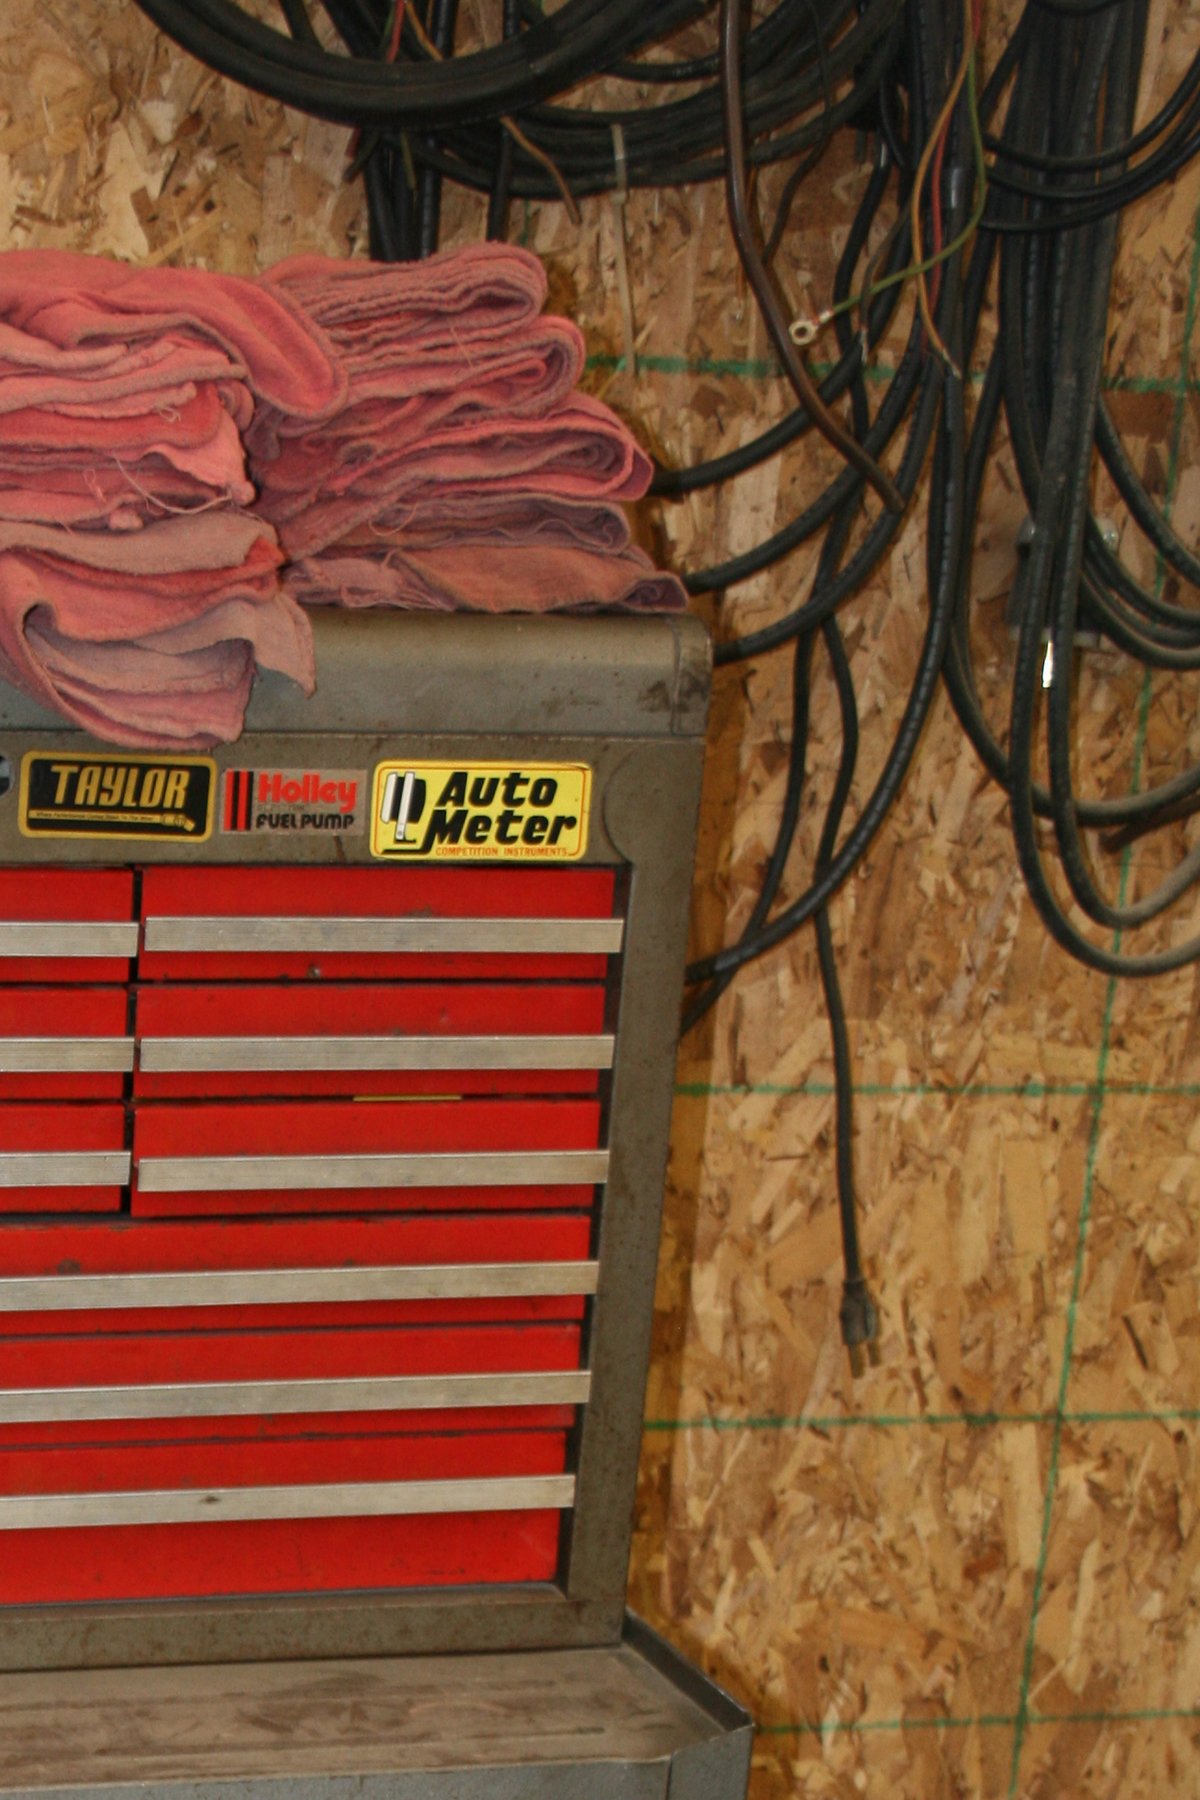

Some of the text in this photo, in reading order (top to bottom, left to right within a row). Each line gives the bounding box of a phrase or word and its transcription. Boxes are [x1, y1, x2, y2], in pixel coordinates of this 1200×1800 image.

[51, 765, 190, 809] TAYLOR
[258, 772, 357, 813] Holley
[435, 771, 558, 808] Auto
[256, 813, 355, 829] FUEL PUMP
[422, 809, 577, 852] Meter
[435, 847, 568, 857] COMPETITION INSTRUMENTS
